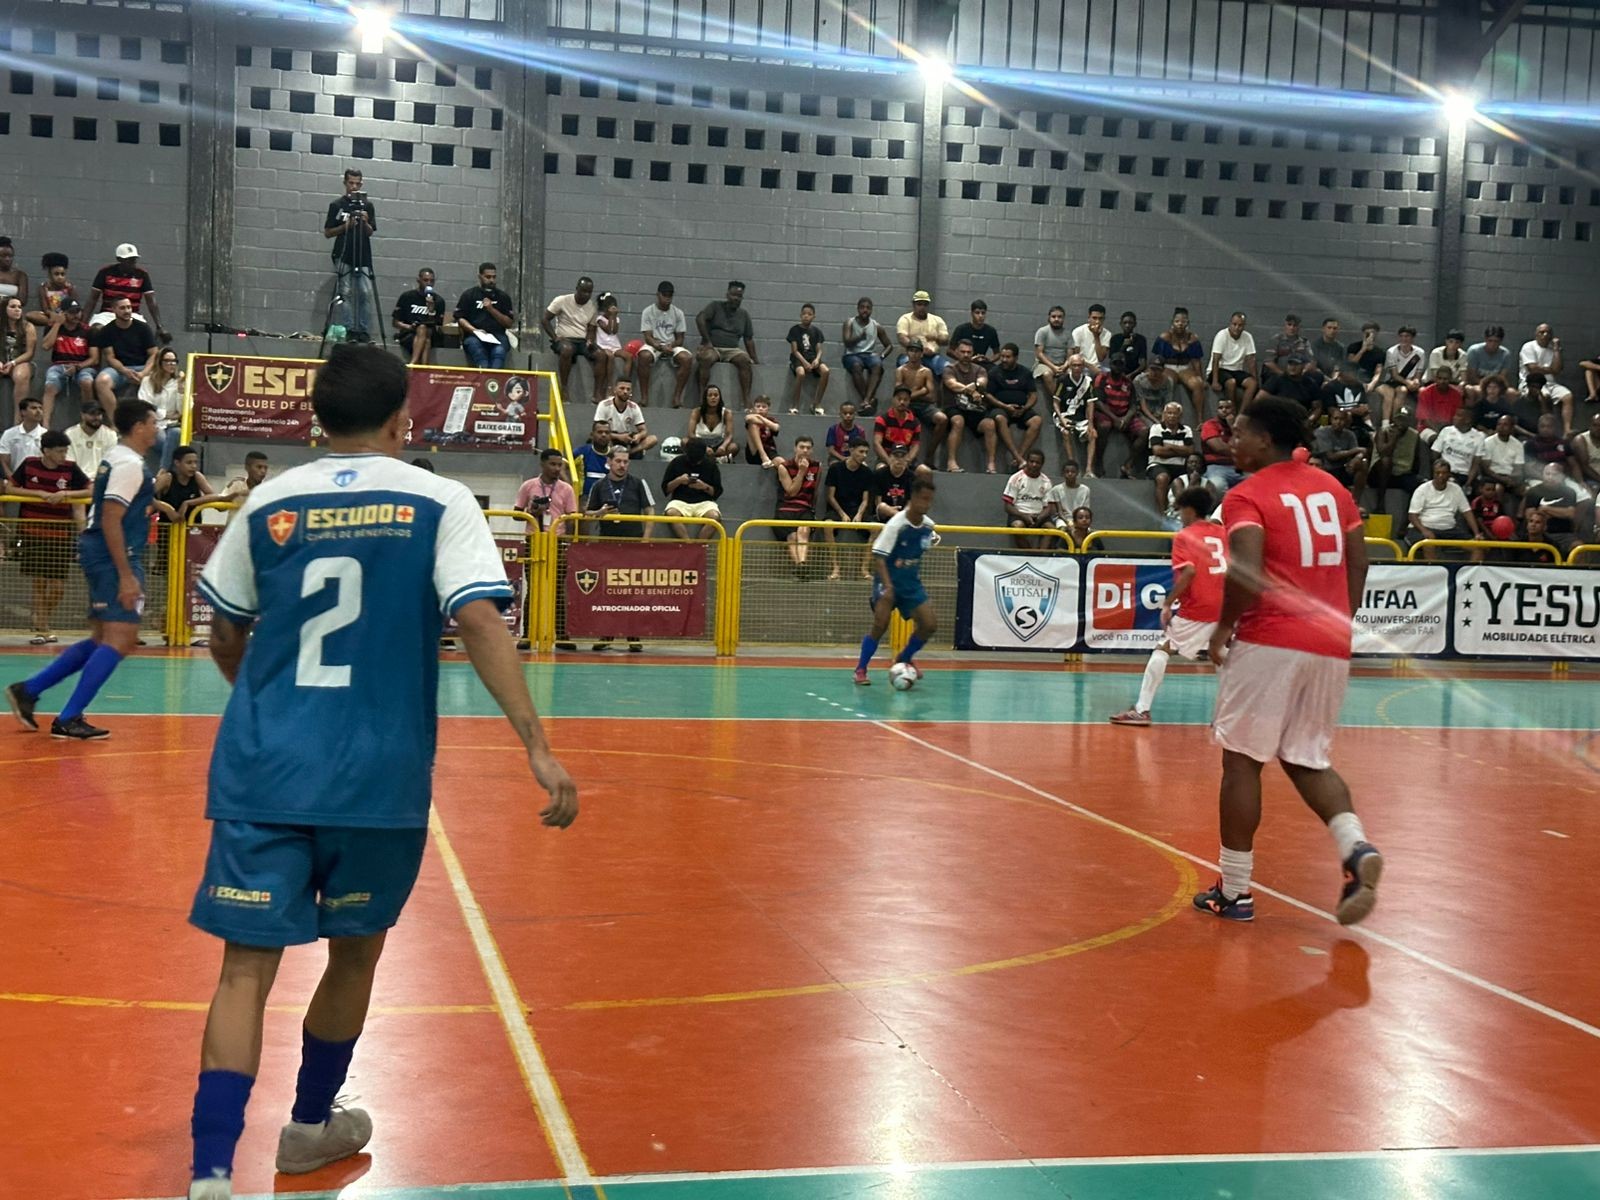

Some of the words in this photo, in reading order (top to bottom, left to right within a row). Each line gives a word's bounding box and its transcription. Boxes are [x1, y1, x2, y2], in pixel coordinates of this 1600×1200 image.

[236, 398, 276, 410] CLUBE
[281, 401, 296, 410] DE
[1279, 491, 1344, 567] 19
[1203, 536, 1228, 575] 3
[1010, 578, 1025, 586] RIO
[1027, 579, 1044, 587] SUL
[606, 587, 632, 595] CLUBE
[647, 586, 694, 596] BENEFÍCIOS
[1006, 587, 1047, 598] FUTSAL
[1359, 589, 1418, 609] IFAA
[295, 556, 363, 687] 2
[1370, 614, 1441, 624] UNIVERSITÁRIO
[1482, 632, 1549, 643] MOBILIDADE
[1550, 631, 1596, 644] ELÉTRICA
